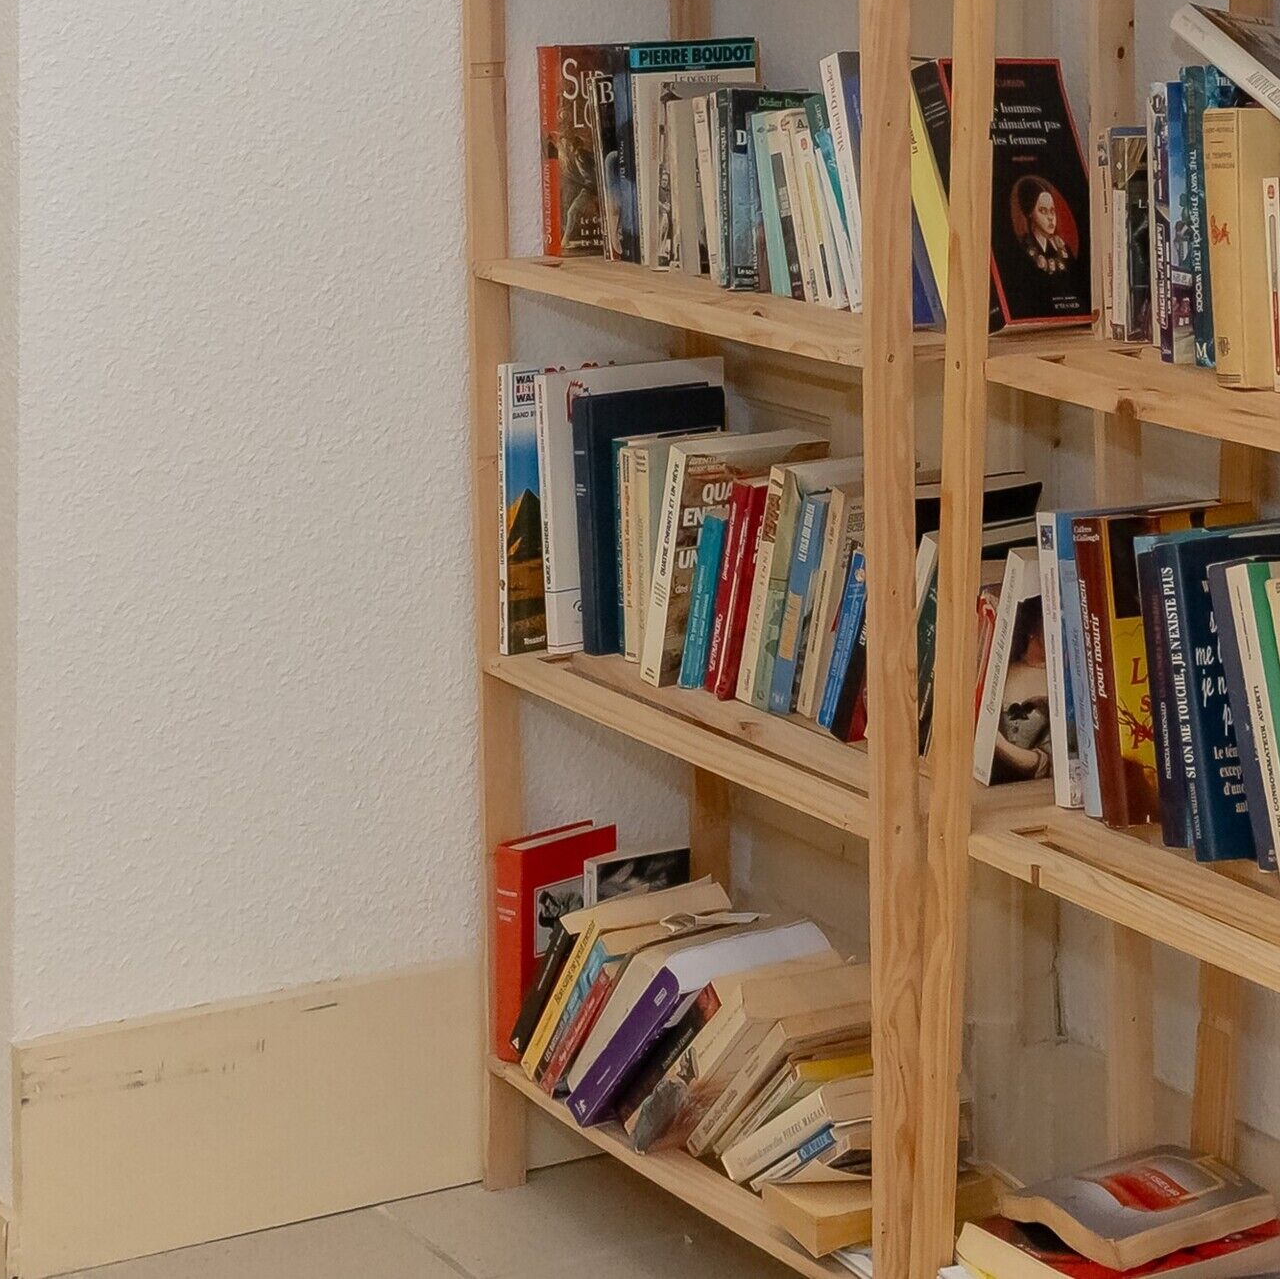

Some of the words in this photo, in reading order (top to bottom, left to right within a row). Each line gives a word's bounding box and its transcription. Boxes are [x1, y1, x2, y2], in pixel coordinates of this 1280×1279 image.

[639, 46, 688, 66] PIERRE
[692, 44, 752, 65] BOUDOT
[824, 63, 840, 109] Drucker
[1001, 102, 1042, 114] hommes
[832, 111, 846, 153] Michel
[1008, 135, 1047, 146] femmes
[1043, 121, 1062, 133] pas
[1188, 149, 1197, 170] THE
[1189, 172, 1199, 196] WAY
[1189, 197, 1202, 246] THROUGH
[1155, 224, 1164, 268] FLUFFY
[1193, 250, 1202, 271] THE
[1195, 273, 1204, 312] WOODS
[512, 411, 529, 419] BAND
[668, 463, 679, 483] RÊVE
[666, 498, 672, 507] ET
[667, 486, 674, 495] UN
[662, 511, 673, 544] ENFANTS
[797, 552, 807, 562] LE
[802, 503, 815, 527] SOLEIL
[659, 547, 668, 577] QUATRE
[1161, 567, 1176, 594] PLUS
[750, 595, 762, 642] STEFANO
[758, 550, 768, 586] BENNI
[1078, 578, 1091, 629] cachent
[1084, 631, 1092, 646] se
[1090, 612, 1102, 661] mourir
[1166, 597, 1183, 650] N'EXISTE
[1173, 652, 1186, 666] JE
[1196, 646, 1214, 666] me
[1086, 650, 1098, 702] oiseaux
[1095, 663, 1108, 698] pour
[1202, 670, 1214, 708] je
[1173, 668, 1189, 721] TOUCHE,
[1253, 685, 1267, 722] AVERTI
[1160, 701, 1171, 746] MACDONALD
[1180, 725, 1192, 742] ME
[1165, 747, 1173, 779] PATRICIA
[1183, 746, 1194, 763] ON
[1214, 746, 1224, 760] Le
[1185, 766, 1196, 778] SI
[1259, 725, 1280, 812] CONSOMMATEUR
